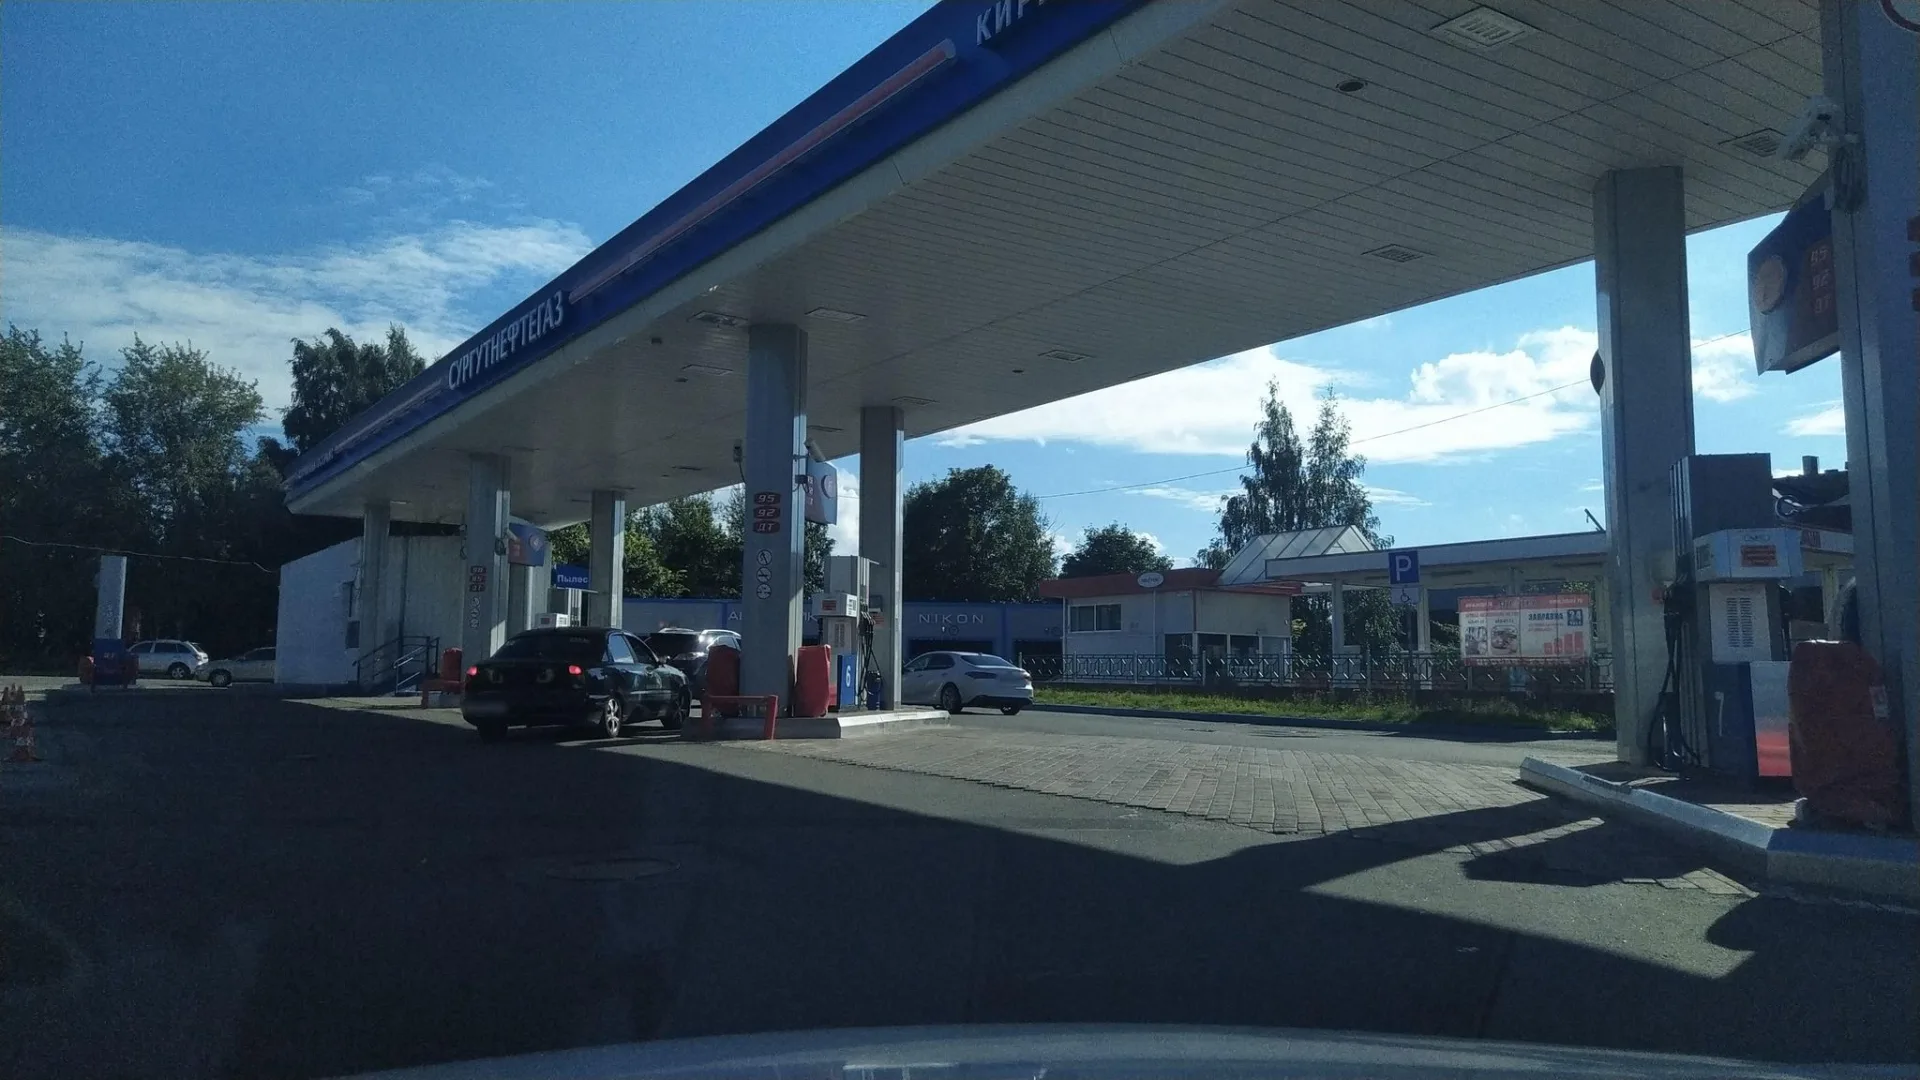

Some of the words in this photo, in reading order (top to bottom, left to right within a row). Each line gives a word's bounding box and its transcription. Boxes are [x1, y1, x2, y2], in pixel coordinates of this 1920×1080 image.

[449, 290, 563, 390] СУРГУТНЕФТЕГАЗ
[757, 494, 776, 503] 95
[757, 508, 776, 517] 92
[757, 522, 775, 532] ДТ
[1395, 555, 1412, 581] P
[919, 614, 984, 624] NIKON
[845, 664, 852, 687] 6
